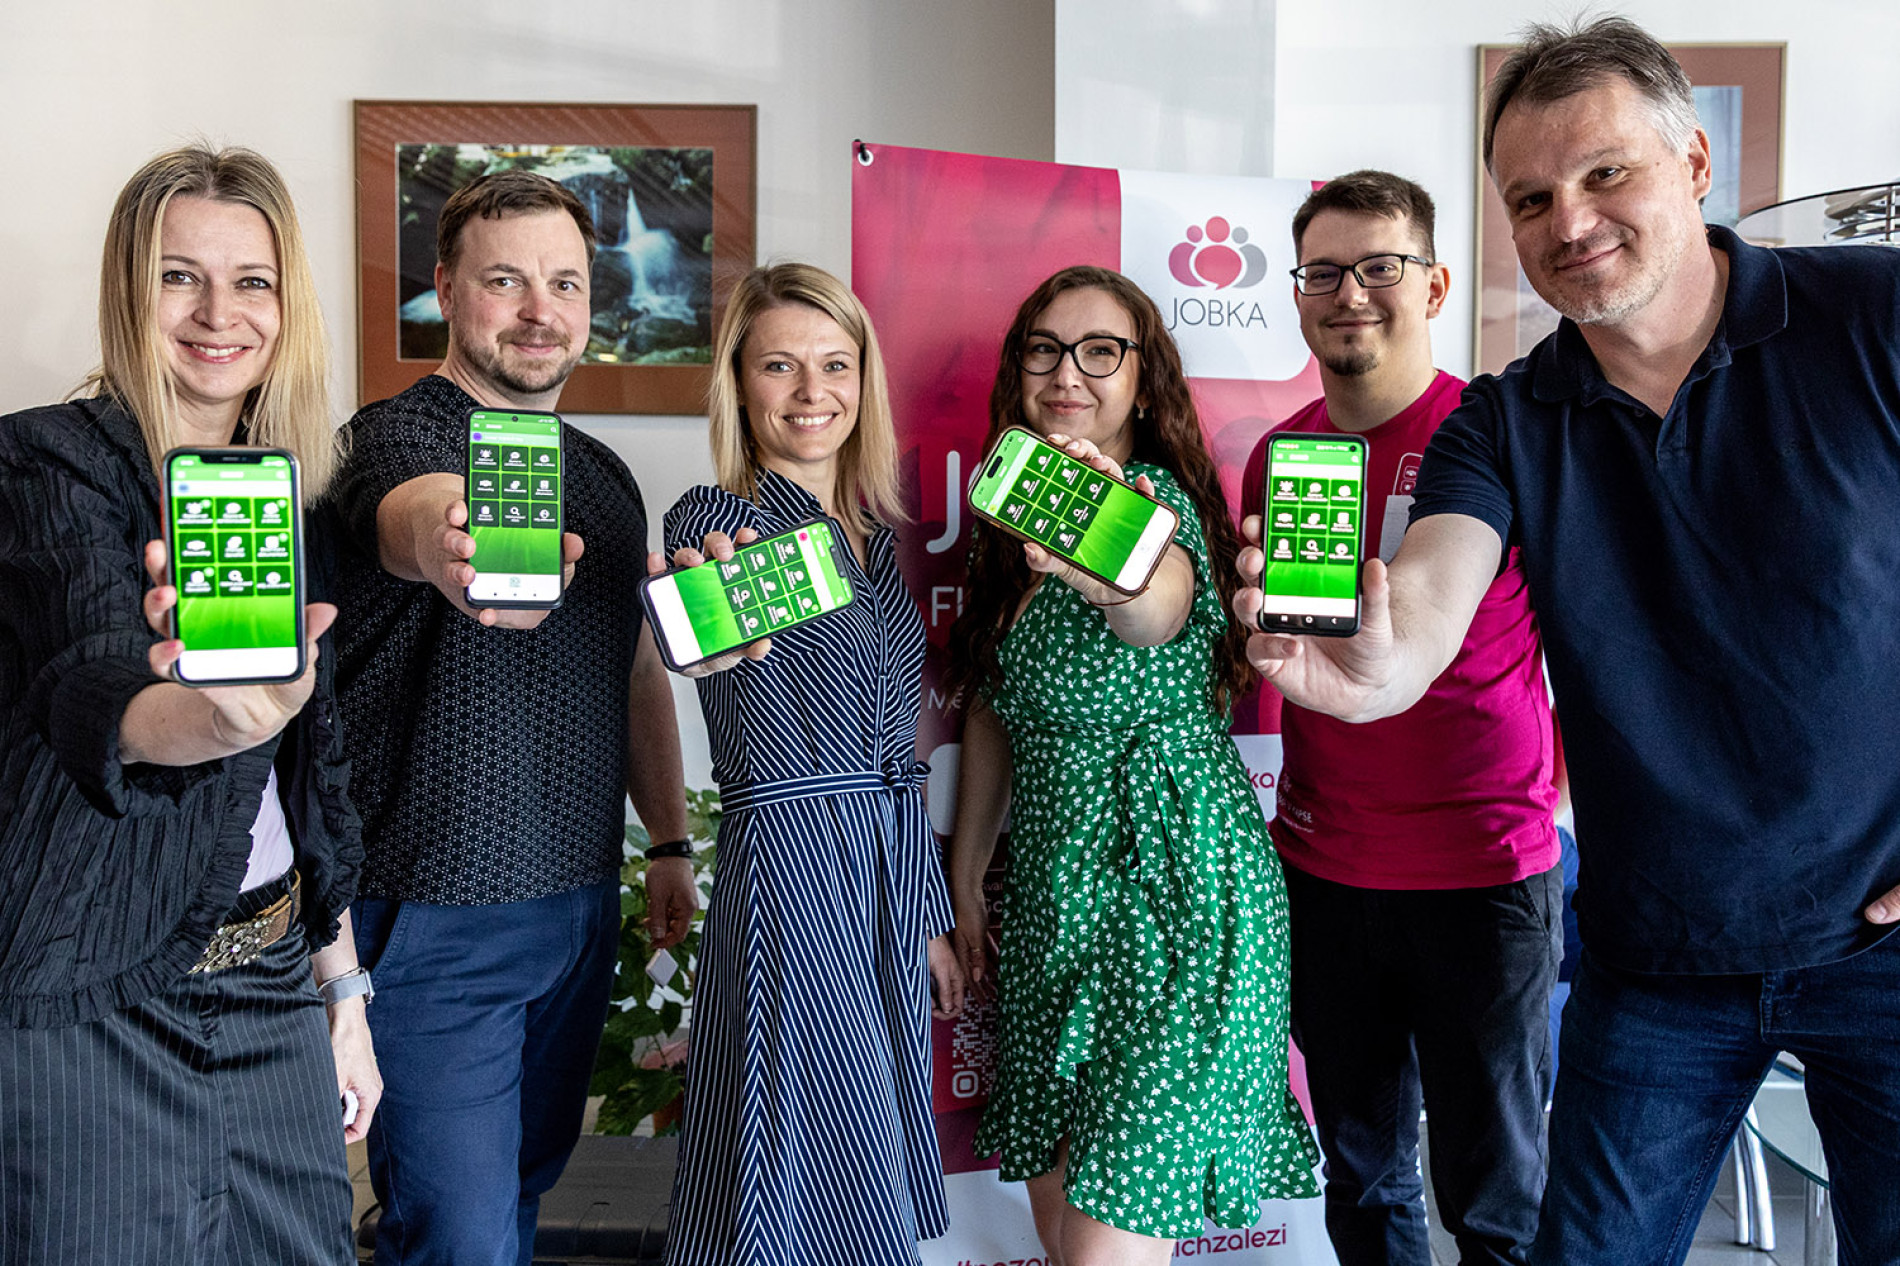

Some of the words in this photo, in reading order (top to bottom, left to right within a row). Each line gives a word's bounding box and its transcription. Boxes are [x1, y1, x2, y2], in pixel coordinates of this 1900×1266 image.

[1168, 297, 1268, 331] JOBKA
[925, 450, 981, 554] J
[1171, 1223, 1287, 1257] ichzalezi
